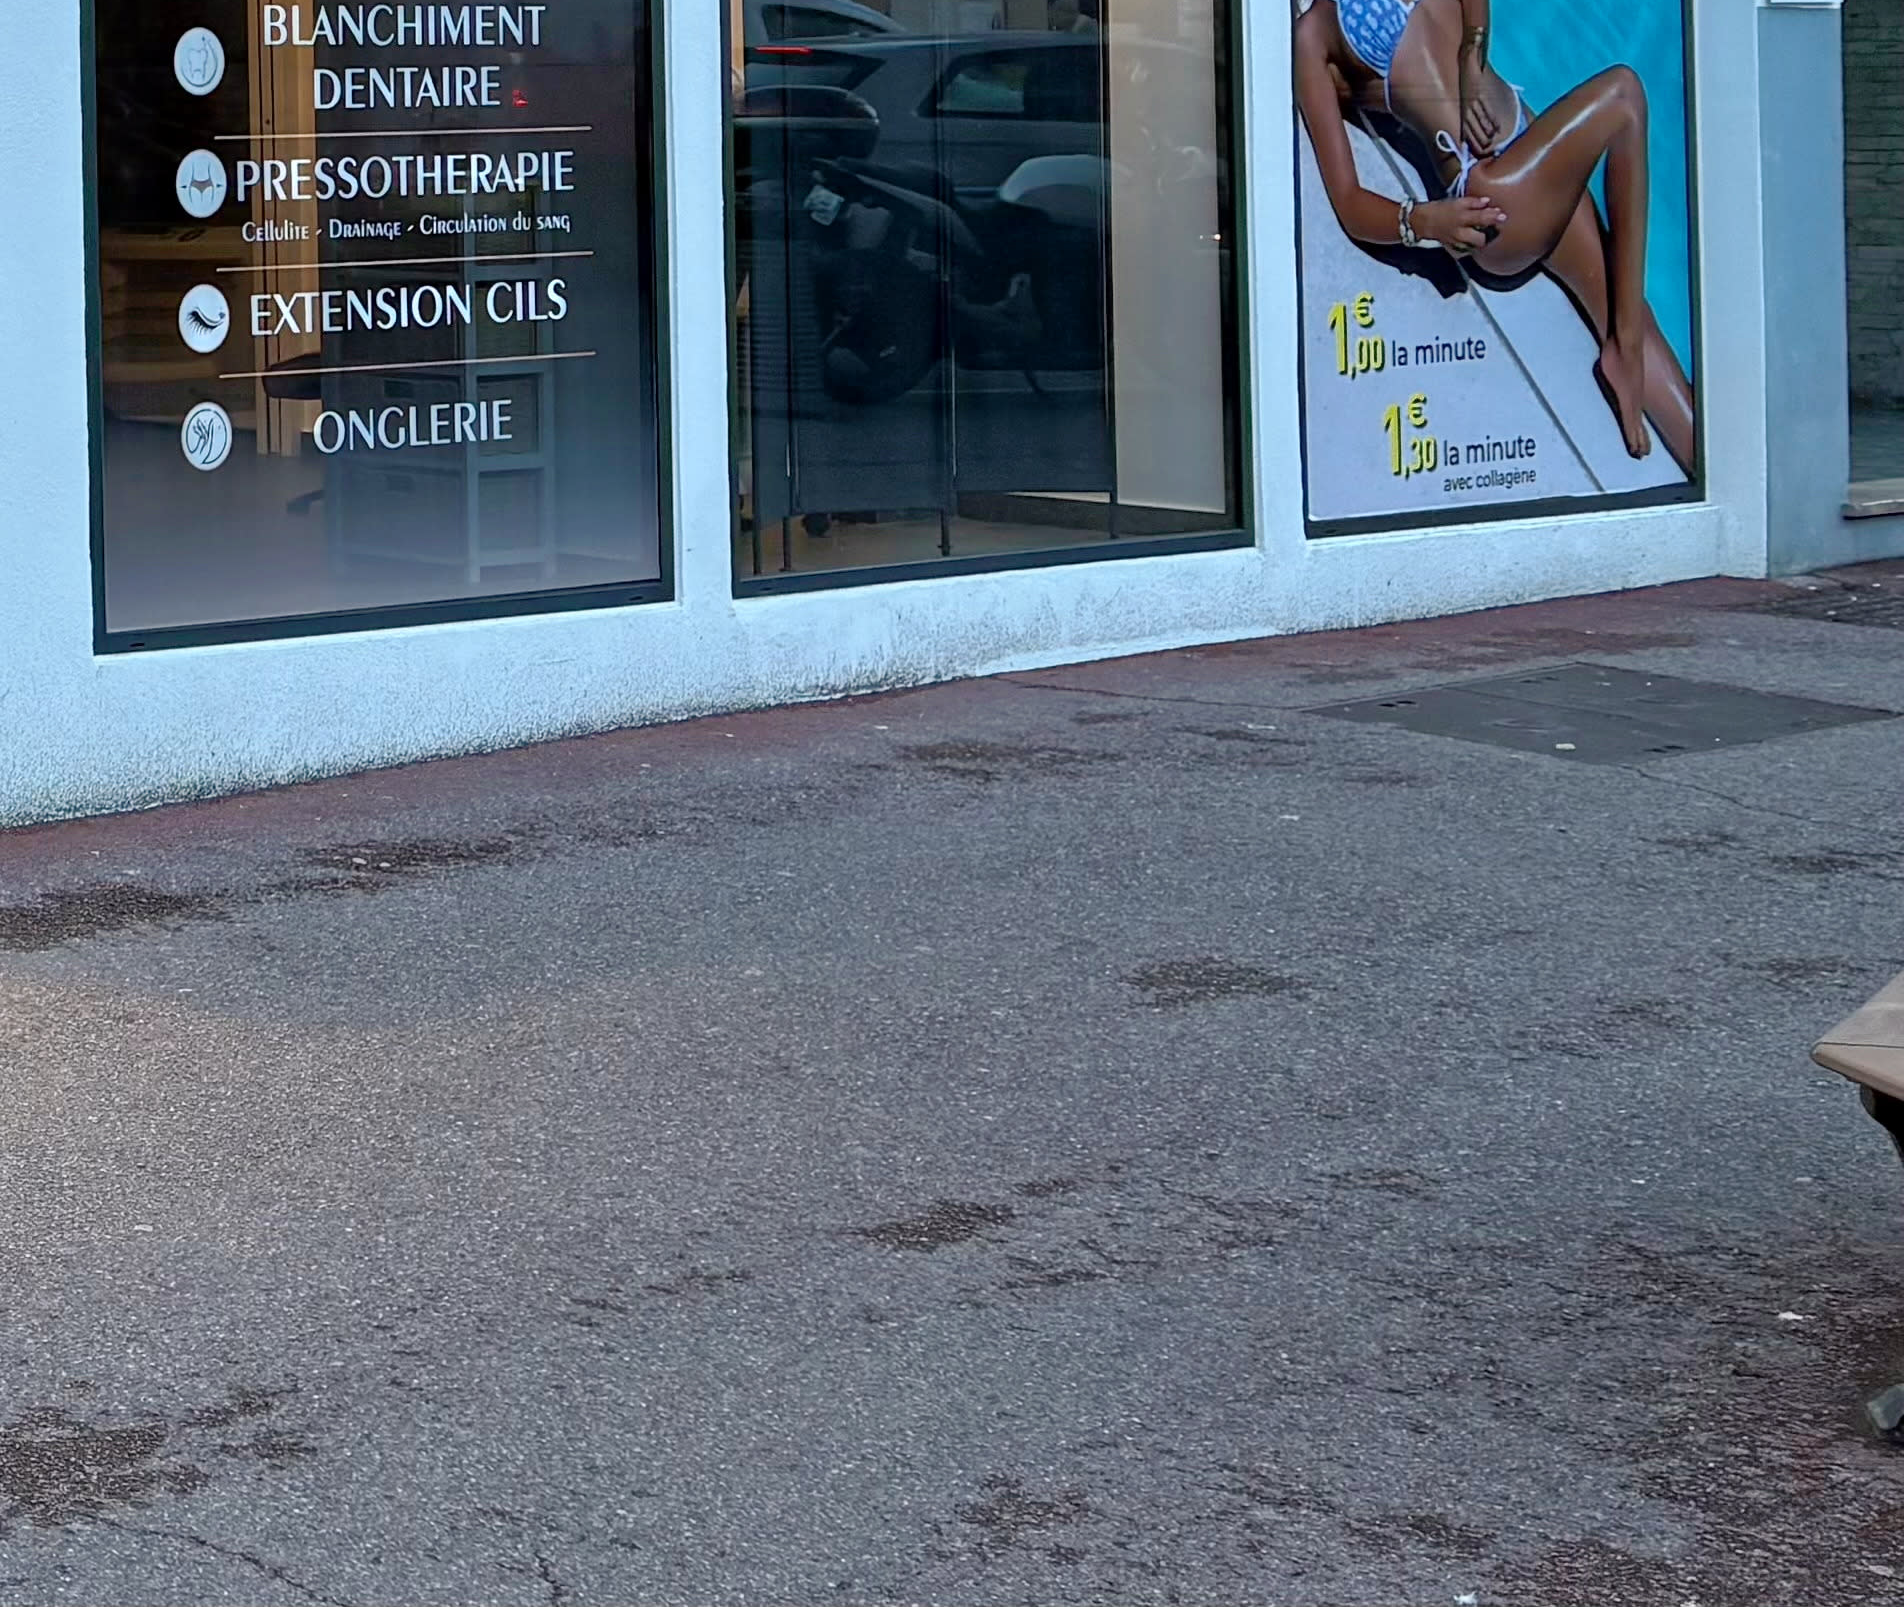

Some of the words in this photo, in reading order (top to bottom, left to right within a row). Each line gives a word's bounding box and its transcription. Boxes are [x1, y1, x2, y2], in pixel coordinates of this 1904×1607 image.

[263, 4, 546, 46] BLANCHIMENT
[314, 66, 501, 110] DENTAIRE
[235, 151, 574, 202] PRESSOTHERAPIE
[250, 283, 472, 337] EXTENSION
[486, 278, 568, 324] CILS
[1392, 340, 1407, 367] la
[1415, 335, 1487, 365] minute
[313, 399, 513, 454] ONGLERIE
[1444, 439, 1459, 466] la
[1467, 435, 1537, 464] minute
[1443, 476, 1472, 492] avec
[1475, 467, 1537, 491] collagène
